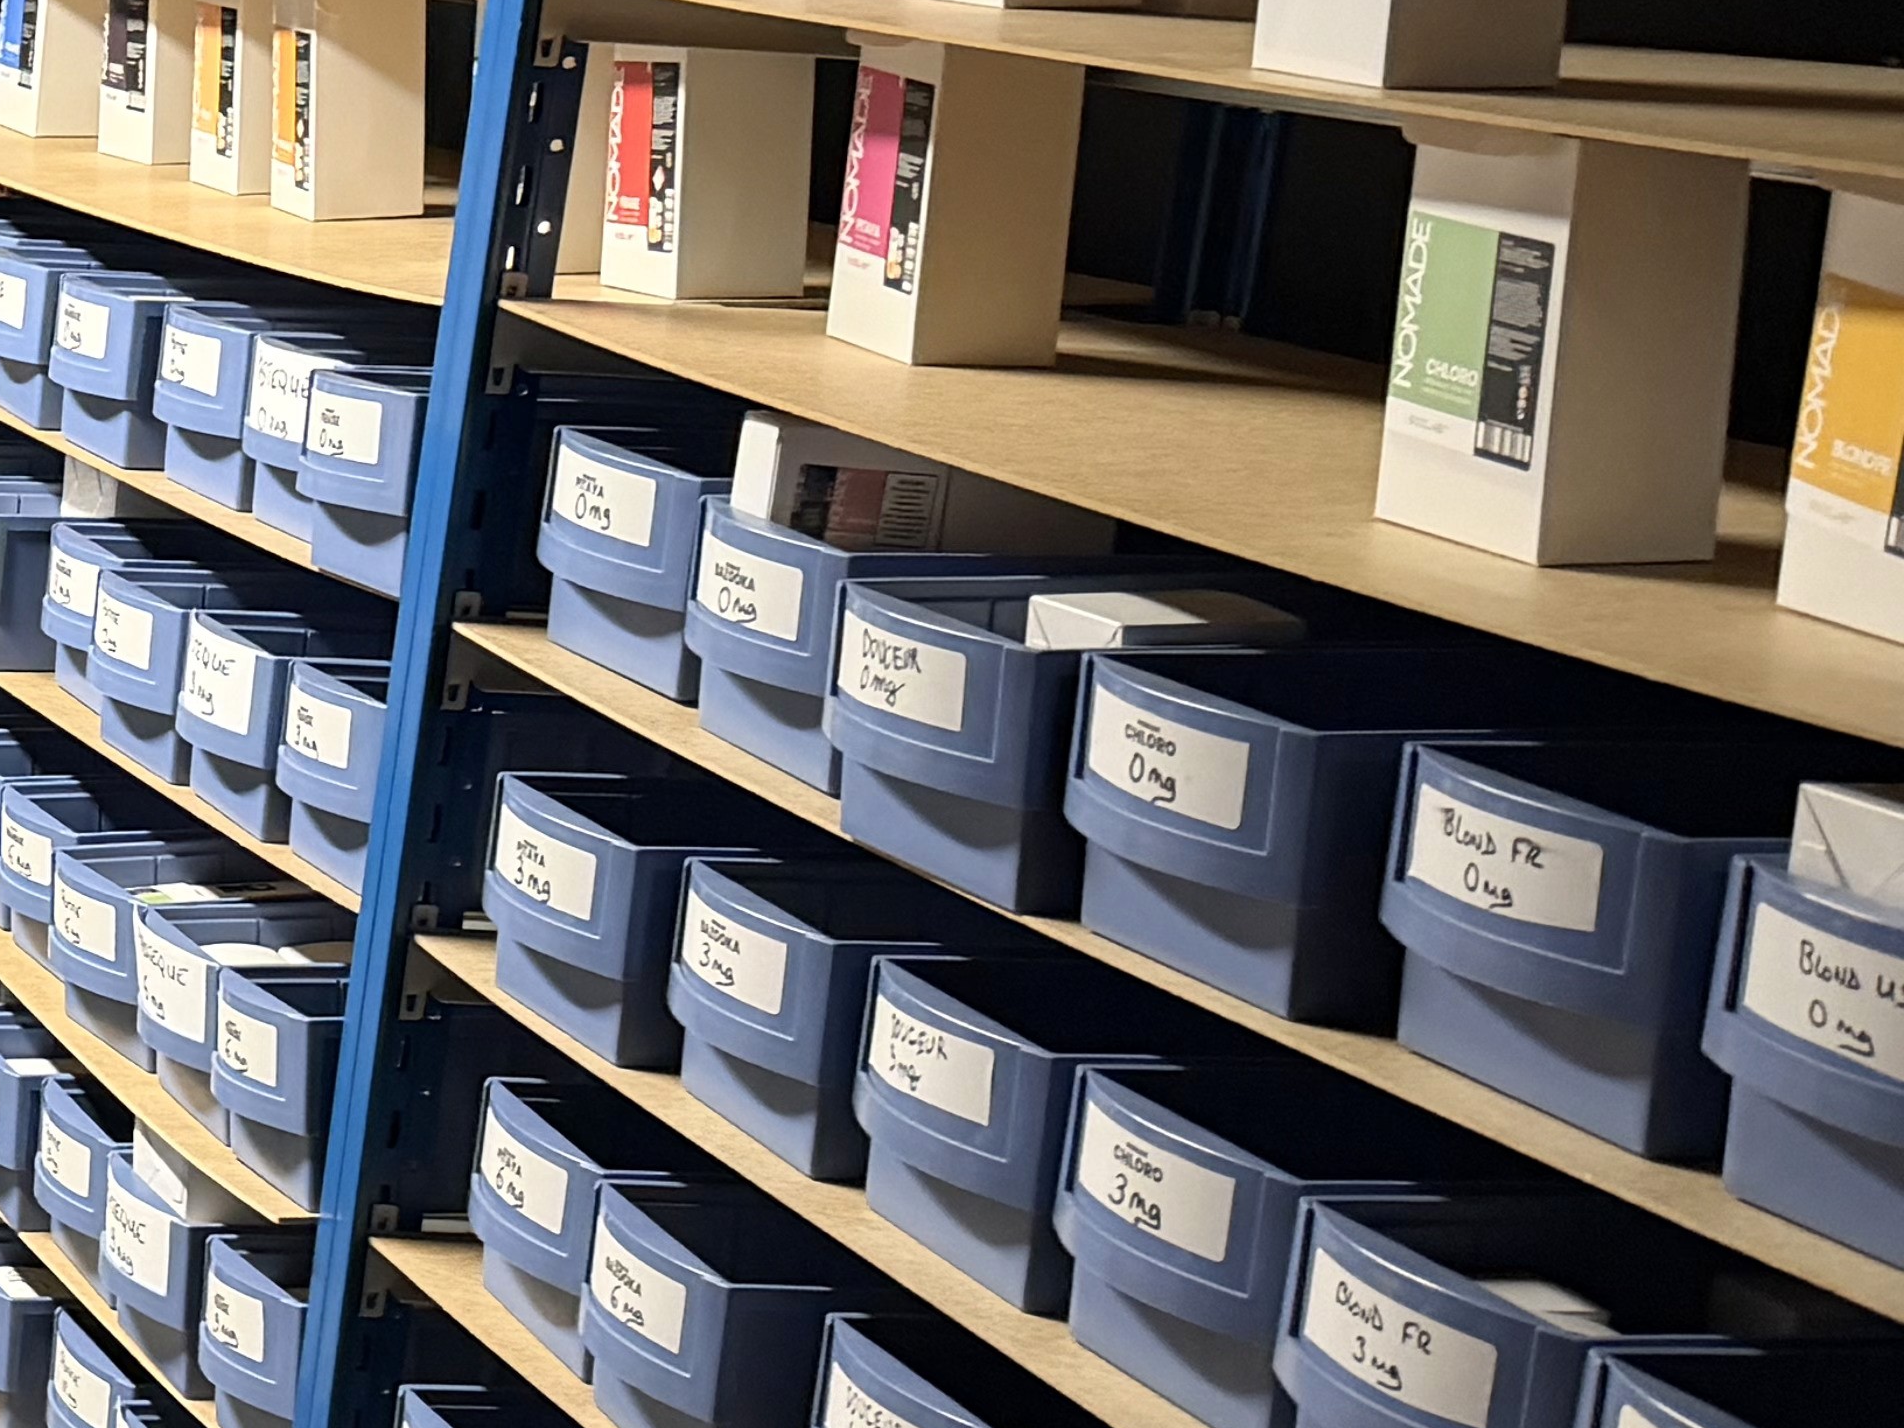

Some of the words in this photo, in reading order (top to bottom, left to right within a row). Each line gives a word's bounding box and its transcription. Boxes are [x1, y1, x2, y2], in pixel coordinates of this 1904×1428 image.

[838, 72, 875, 244] NOMADE
[1392, 217, 1432, 387] NOMADE
[1425, 358, 1478, 388] CHLORO
[861, 628, 923, 673] DOUCEUR
[1125, 723, 1177, 756] CHLORO
[1114, 1143, 1164, 1183] CHLORO
